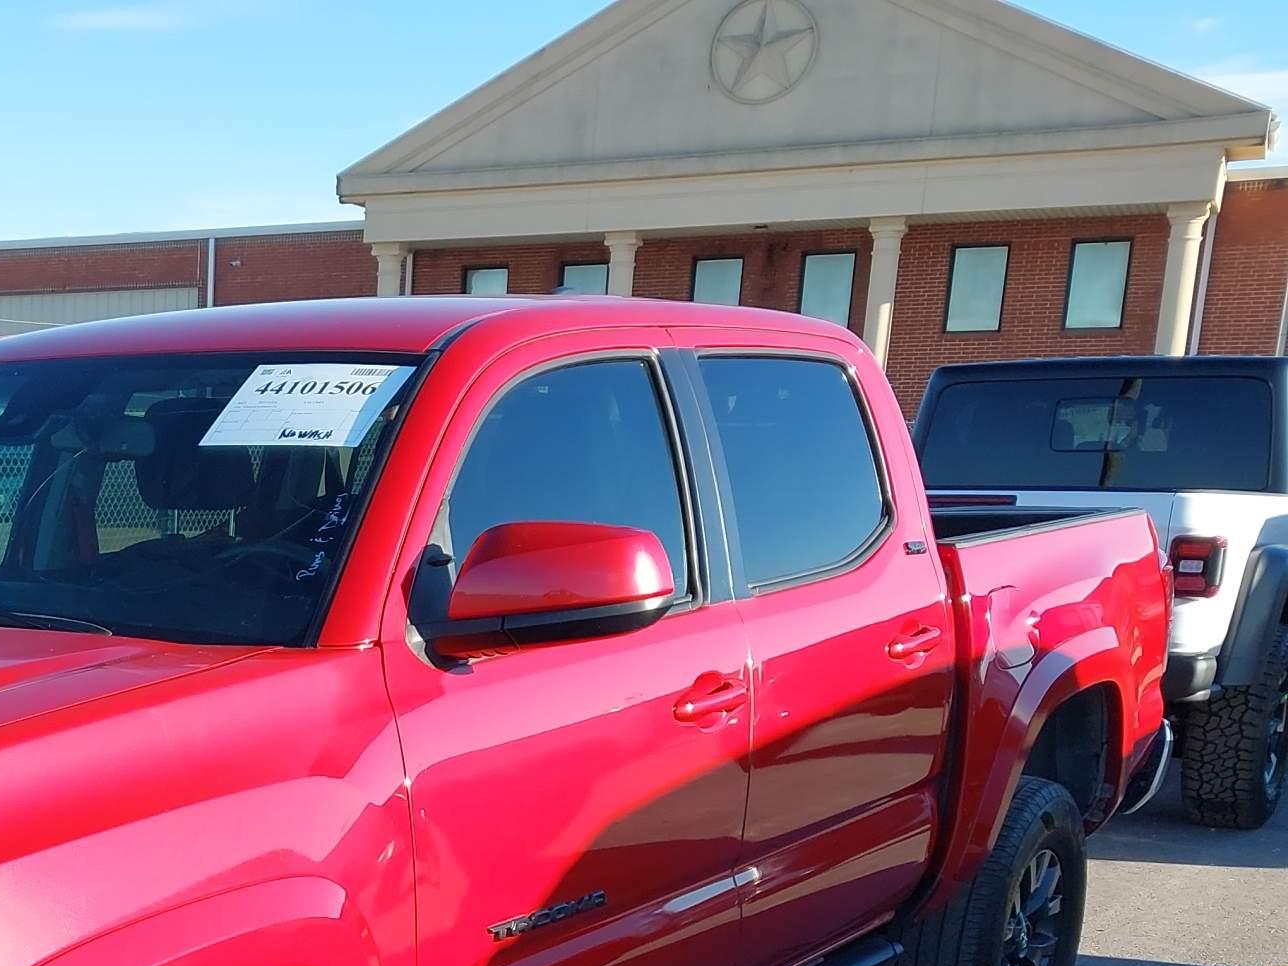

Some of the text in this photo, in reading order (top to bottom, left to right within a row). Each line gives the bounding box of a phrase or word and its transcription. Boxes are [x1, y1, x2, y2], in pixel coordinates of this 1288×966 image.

[255, 380, 384, 396] 44101506
[297, 429, 334, 440] WASH
[486, 889, 605, 942] TACOMA
